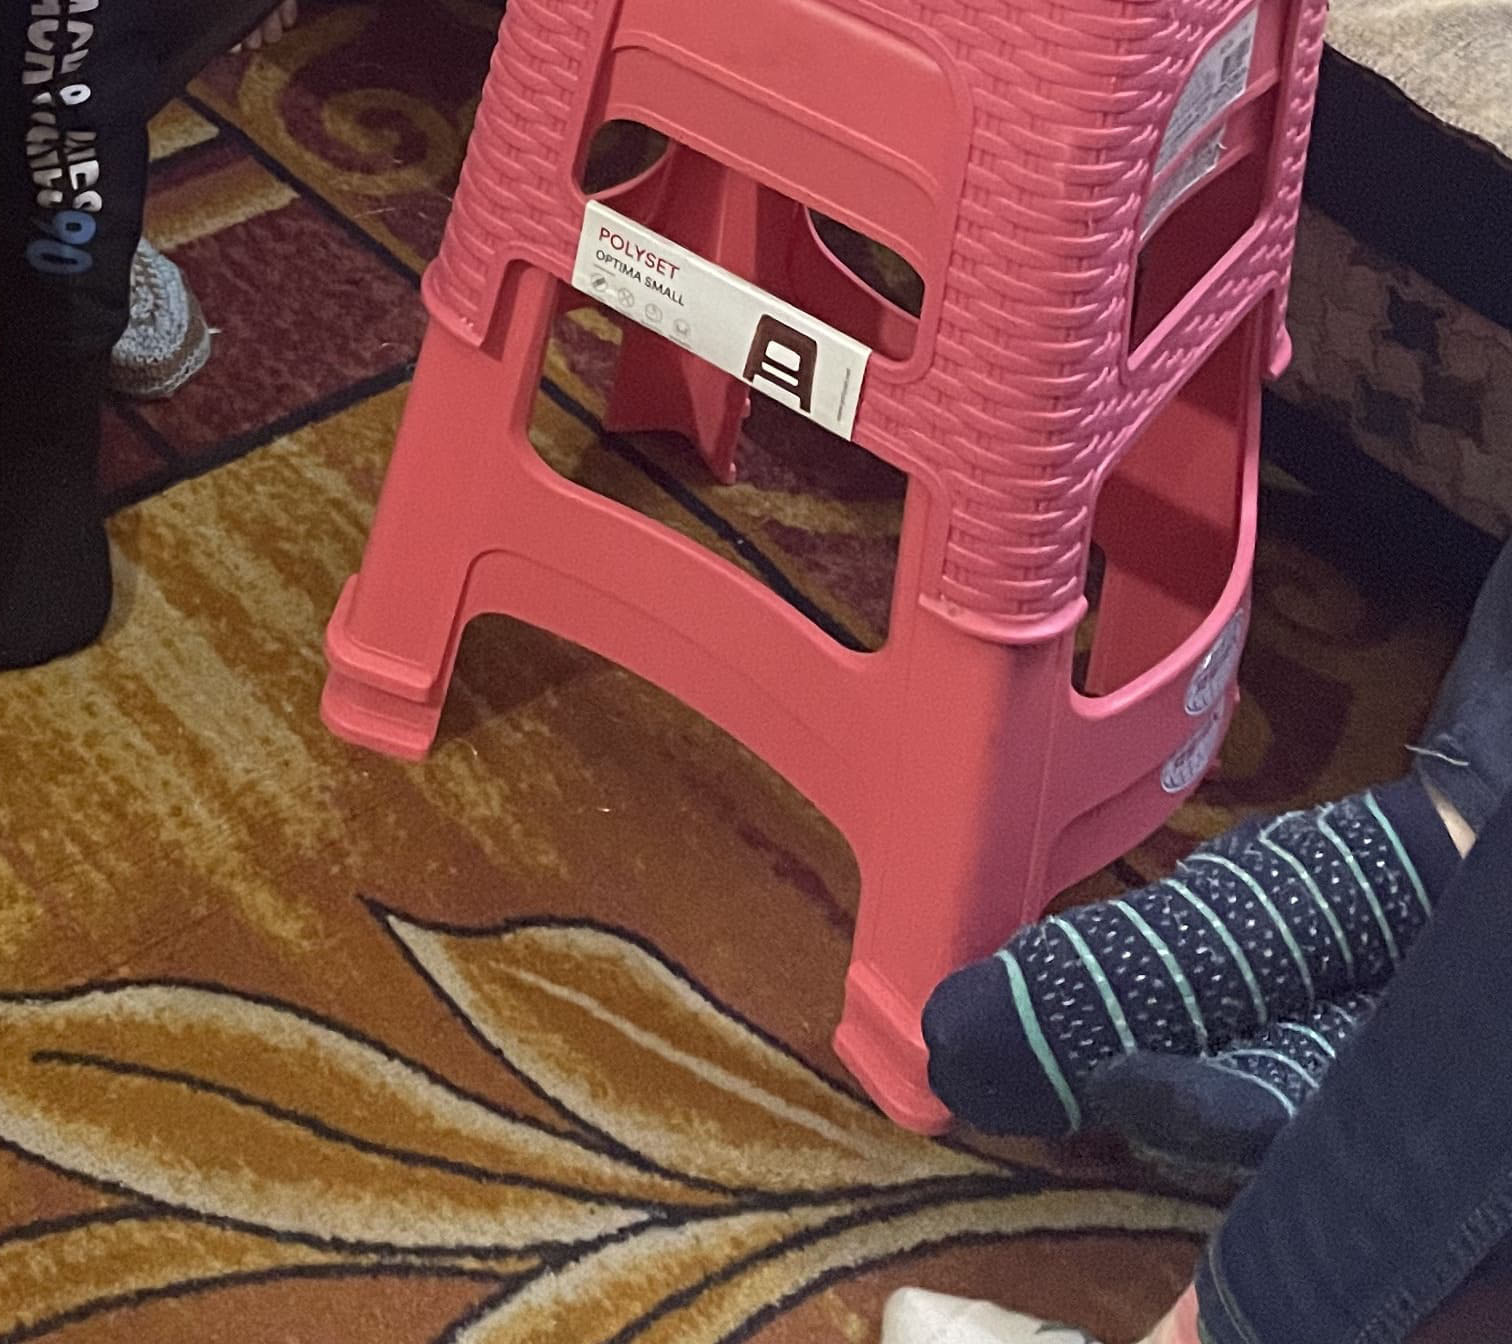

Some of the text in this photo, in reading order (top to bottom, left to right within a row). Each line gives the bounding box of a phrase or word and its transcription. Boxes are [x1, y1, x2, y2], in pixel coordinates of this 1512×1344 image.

[595, 249, 642, 283] OPTIMA
[644, 276, 685, 307] SMALL
[598, 226, 680, 280] POLYSET
